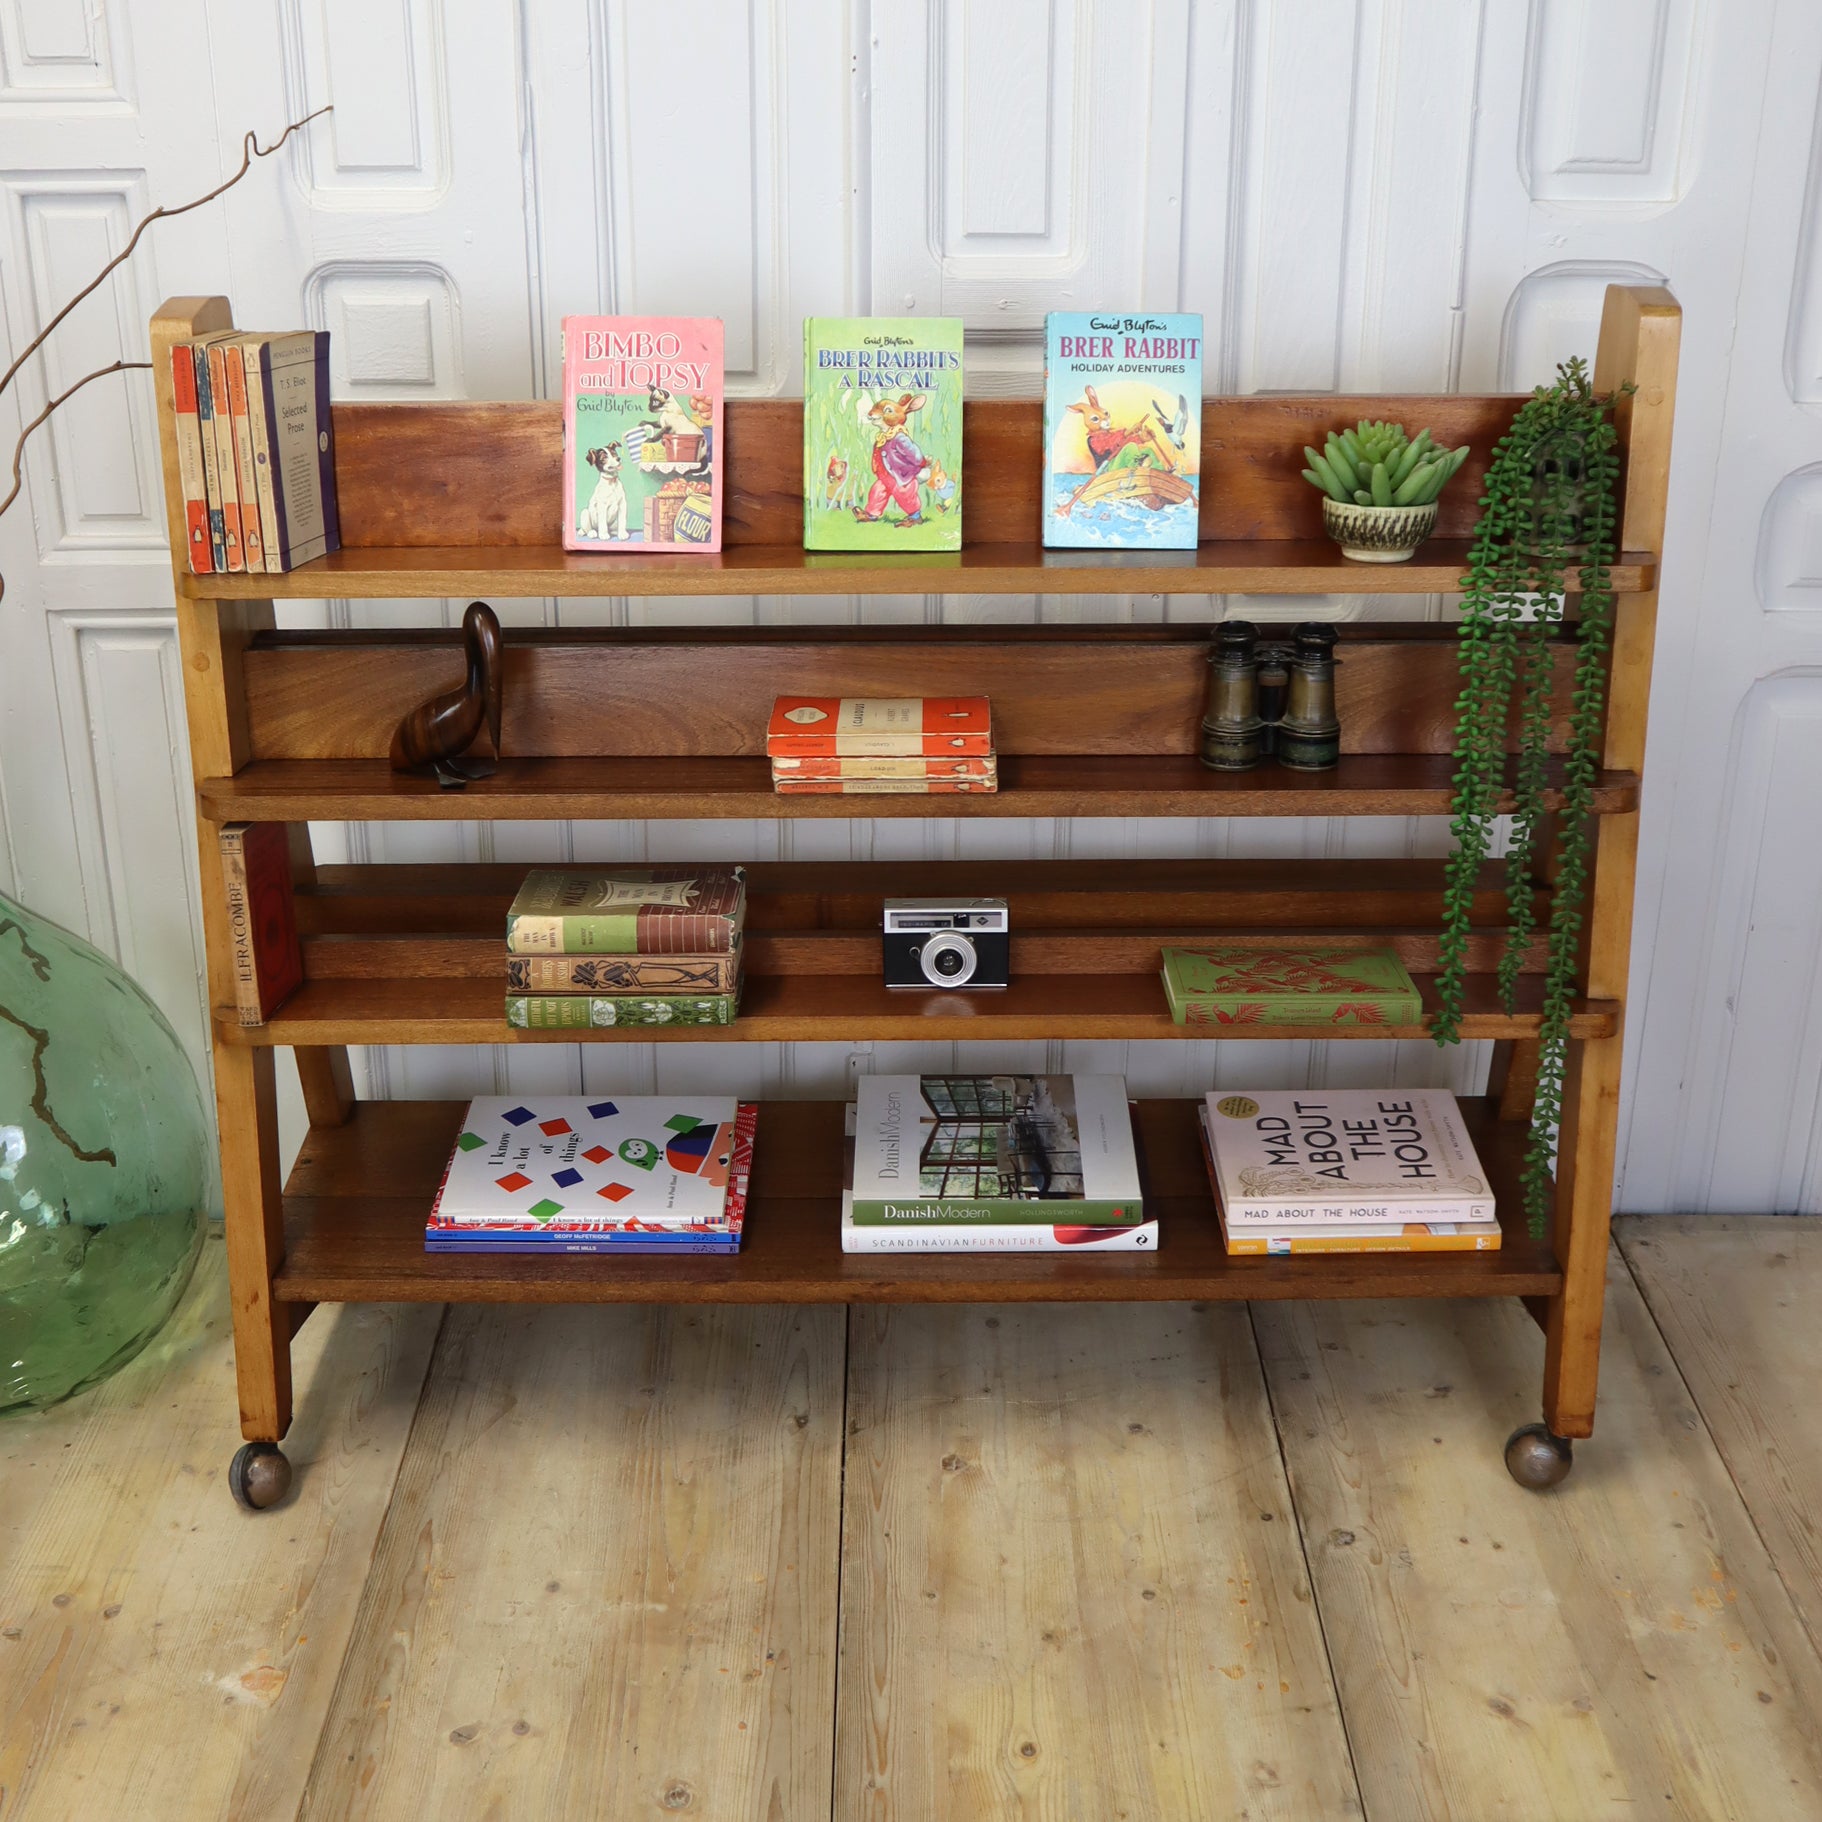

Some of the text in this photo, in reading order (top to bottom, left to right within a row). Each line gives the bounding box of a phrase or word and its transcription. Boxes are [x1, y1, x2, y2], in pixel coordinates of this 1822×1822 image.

[1090, 318, 1167, 333] Enid Blyton's
[583, 331, 680, 360] BIMBO
[864, 337, 882, 347] Enid
[1059, 336, 1200, 360] BRER RABBIT
[818, 349, 960, 369] BRER RABBIT'S
[1071, 363, 1185, 374] HOLIDAY ADVENTURES
[293, 376, 306, 387] Eliot
[580, 360, 710, 390] and TOPSY
[838, 369, 939, 390] A RASCAL
[605, 390, 615, 399] by
[282, 402, 307, 419] Selected
[577, 398, 643, 416] Enid Blyton
[287, 422, 304, 435] Prose
[678, 509, 710, 542] FLOUR
[560, 880, 590, 907] WALSH
[228, 882, 252, 982] ILFRACOMBE
[556, 961, 569, 989] RANSOM
[496, 1131, 511, 1159] know
[539, 1144, 554, 1155] of
[559, 1132, 583, 1163] things
[1256, 1117, 1299, 1165] MAD
[1293, 1101, 1349, 1180] ABOUT
[1343, 1119, 1386, 1161] THE
[1379, 1101, 1437, 1179] HOUSE
[516, 1147, 531, 1170] a lot
[1244, 1207, 1388, 1218] MAD ABOUT THE HOUSE
